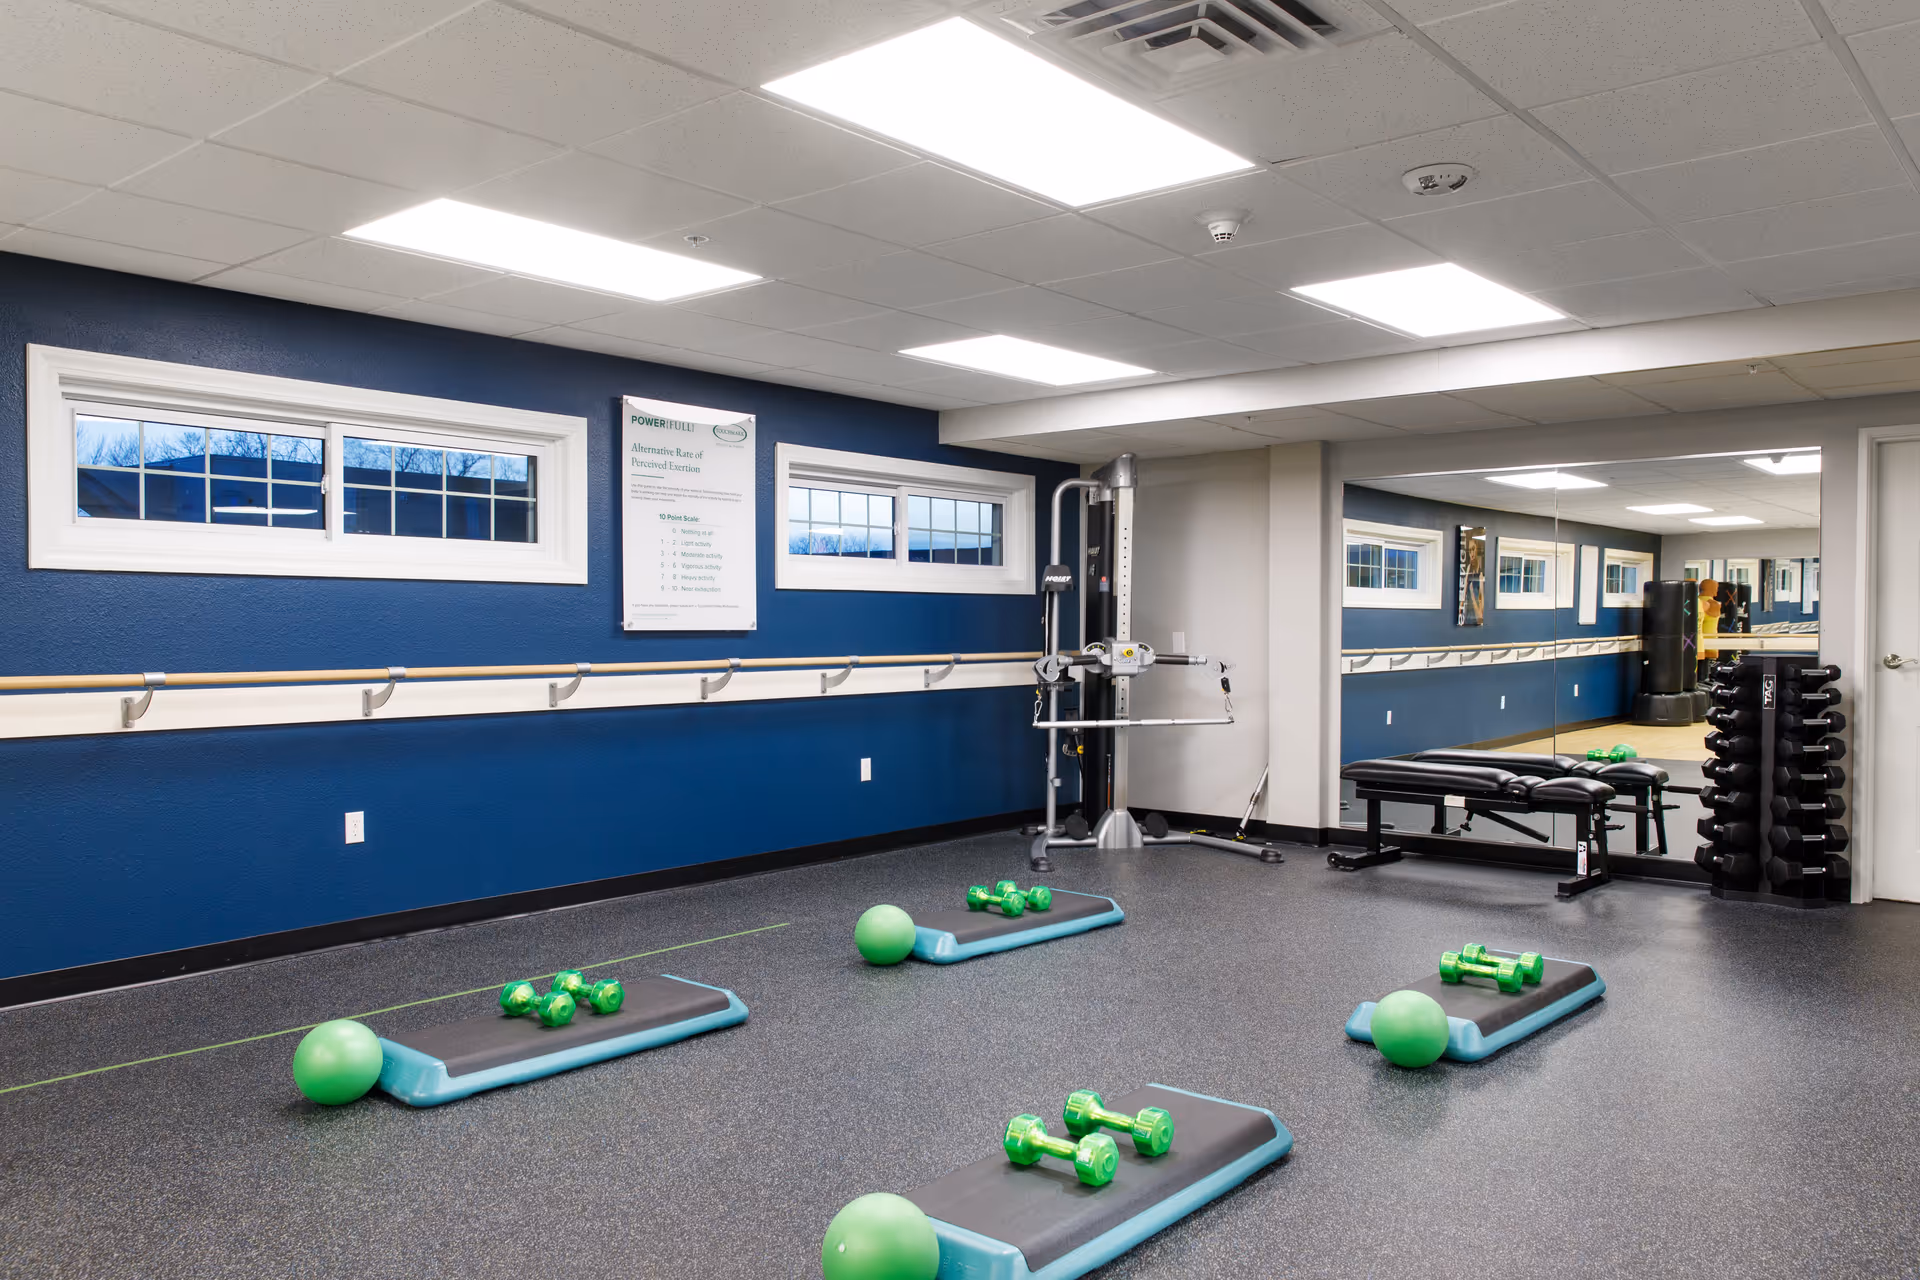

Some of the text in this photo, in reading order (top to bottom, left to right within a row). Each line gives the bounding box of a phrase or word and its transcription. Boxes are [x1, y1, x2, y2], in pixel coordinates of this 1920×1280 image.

[631, 443, 704, 460] Alternative Rate of
[631, 457, 701, 473] Perceived Exertion
[683, 515, 701, 523] Scale:
[681, 540, 694, 548] Light
[681, 551, 705, 559] Moderate
[1764, 679, 1774, 705] TAG
